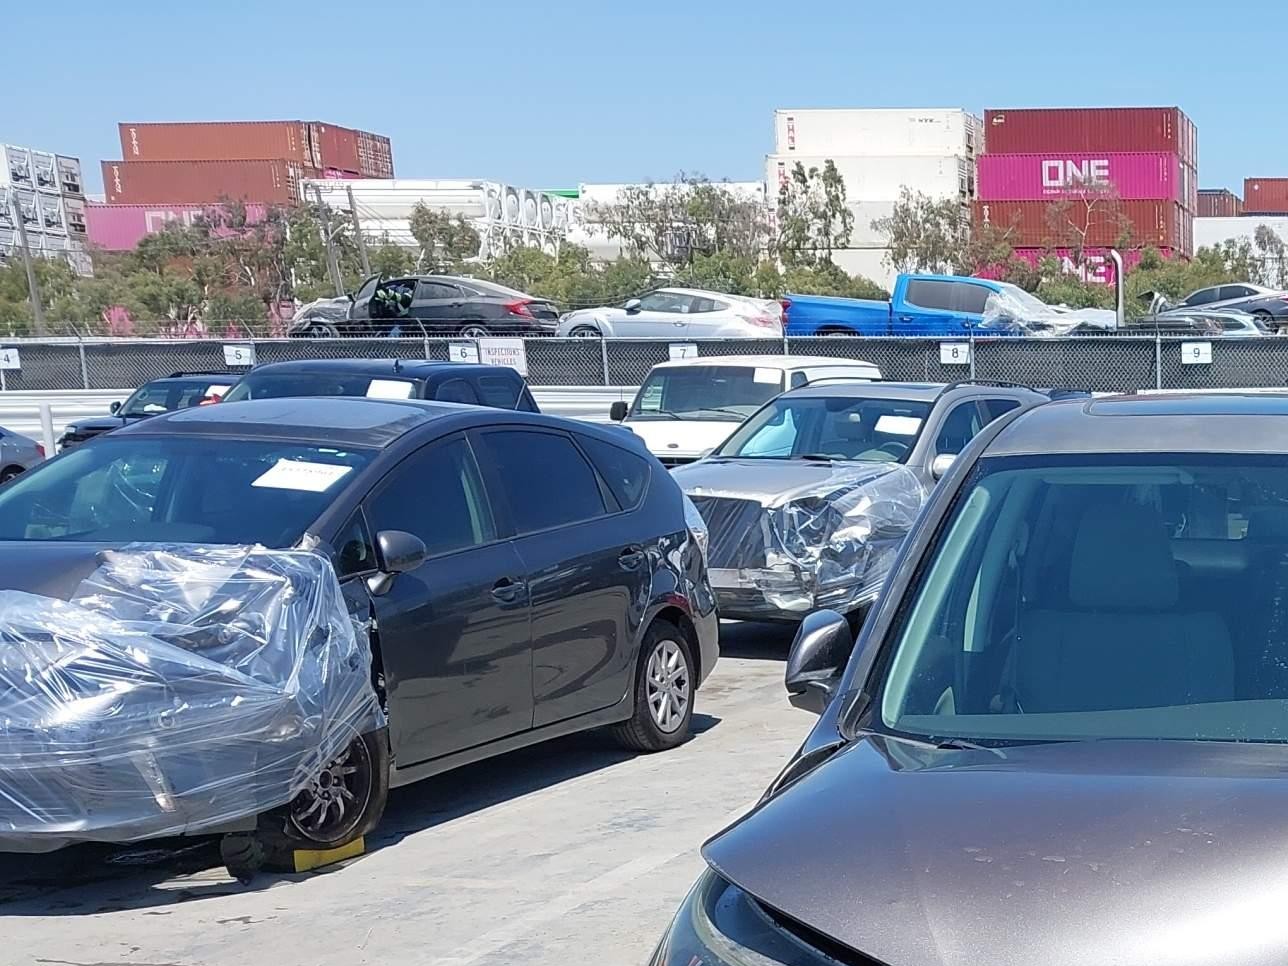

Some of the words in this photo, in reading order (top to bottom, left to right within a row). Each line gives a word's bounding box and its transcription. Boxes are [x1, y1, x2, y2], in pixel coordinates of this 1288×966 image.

[1042, 159, 1109, 187] ONE
[235, 349, 242, 360] 5
[460, 347, 468, 359] 6
[679, 348, 687, 359] 7
[952, 347, 959, 359] 8
[1193, 347, 1200, 358] 9
[3, 353, 10, 364] 4
